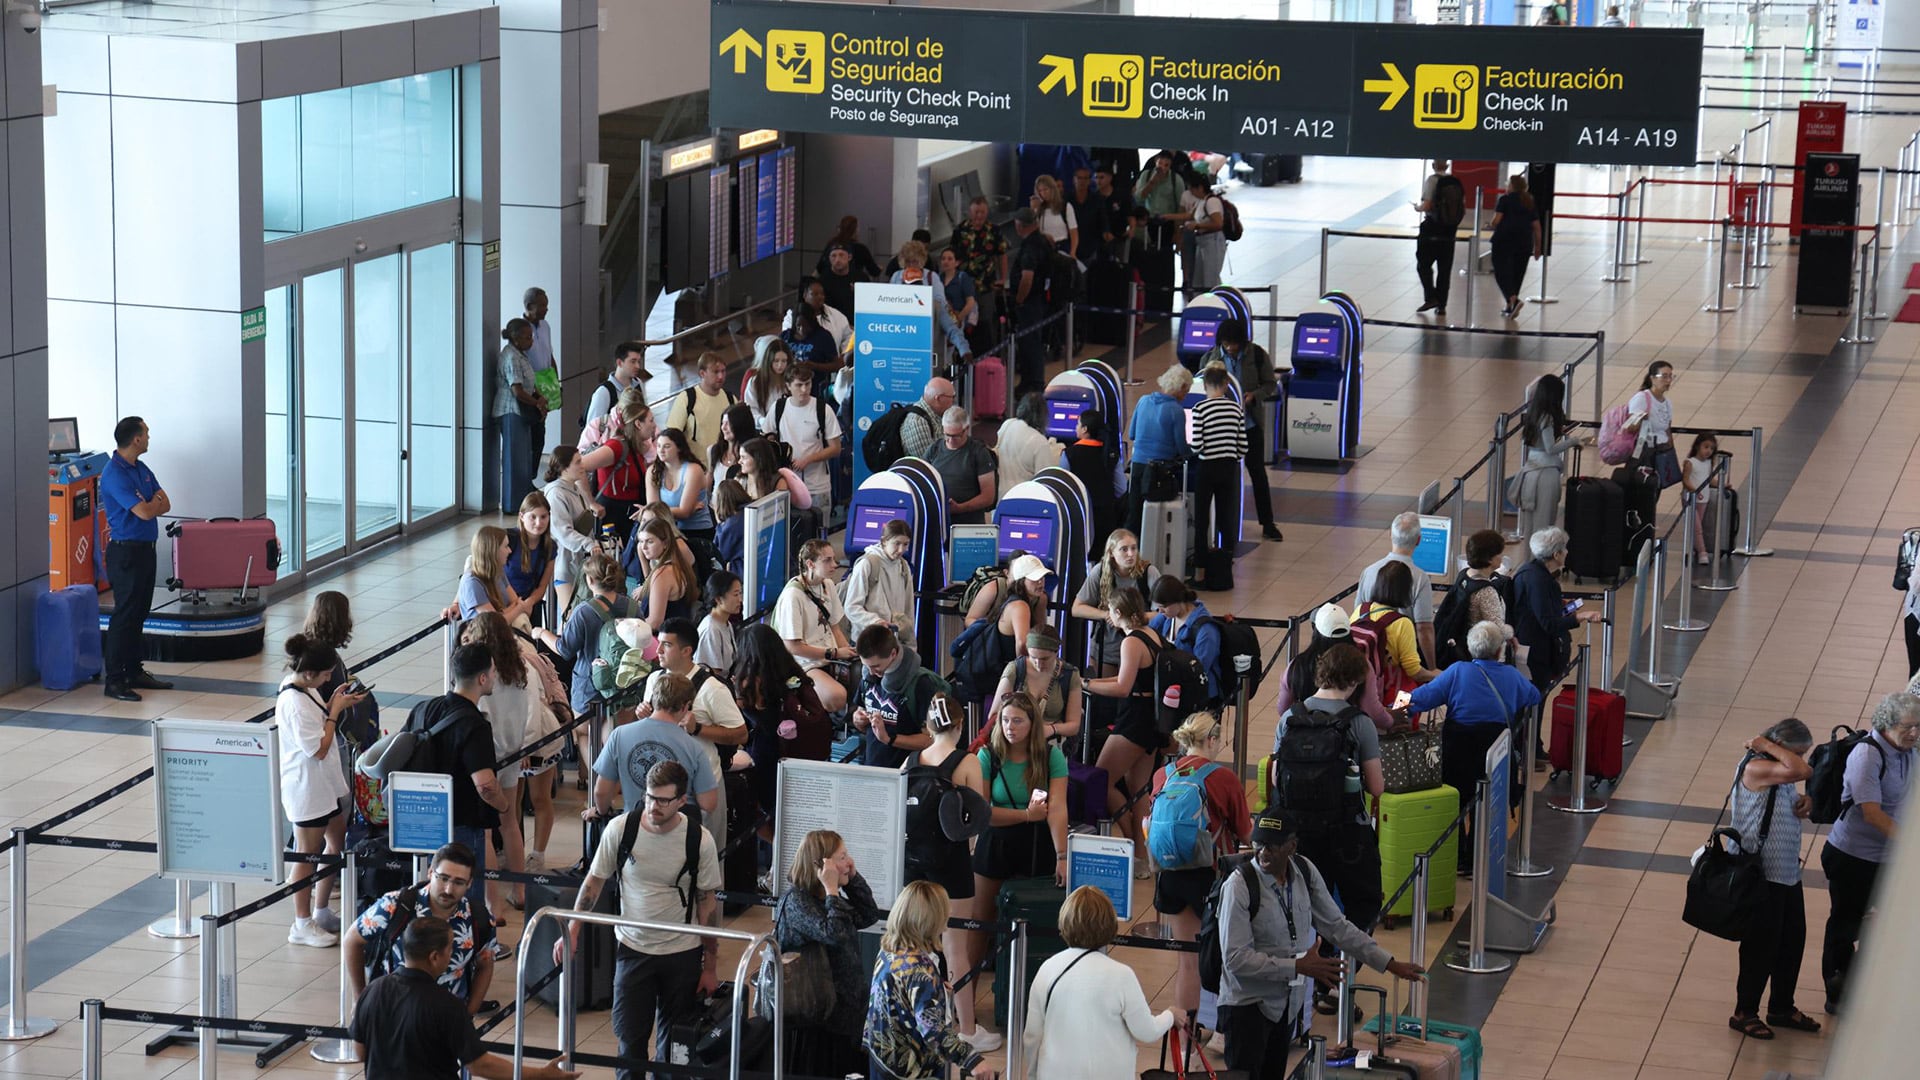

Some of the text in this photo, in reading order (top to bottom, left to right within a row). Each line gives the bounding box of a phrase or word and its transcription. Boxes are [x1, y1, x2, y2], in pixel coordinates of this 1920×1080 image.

[830, 32, 944, 58] Control de
[830, 57, 942, 85] Seguridad
[1150, 56, 1280, 81] Facturación
[1485, 65, 1624, 90] Facturación
[831, 83, 1011, 109] Security Check Point
[1149, 82, 1229, 102] Check In
[1485, 92, 1568, 112] Check In
[830, 106, 959, 128] Posto de Segurança
[1148, 105, 1206, 120] Check-in
[1239, 116, 1278, 136] A01
[1294, 118, 1335, 138] A12
[1483, 116, 1544, 131] Check-in
[1577, 126, 1620, 146] A14
[1634, 128, 1677, 147] A19
[1813, 184, 1848, 192] AIRLINES
[877, 295, 914, 304] American
[867, 322, 917, 334] CHECK-IN
[215, 737, 253, 748] American
[167, 757, 208, 766] PRIORITY
